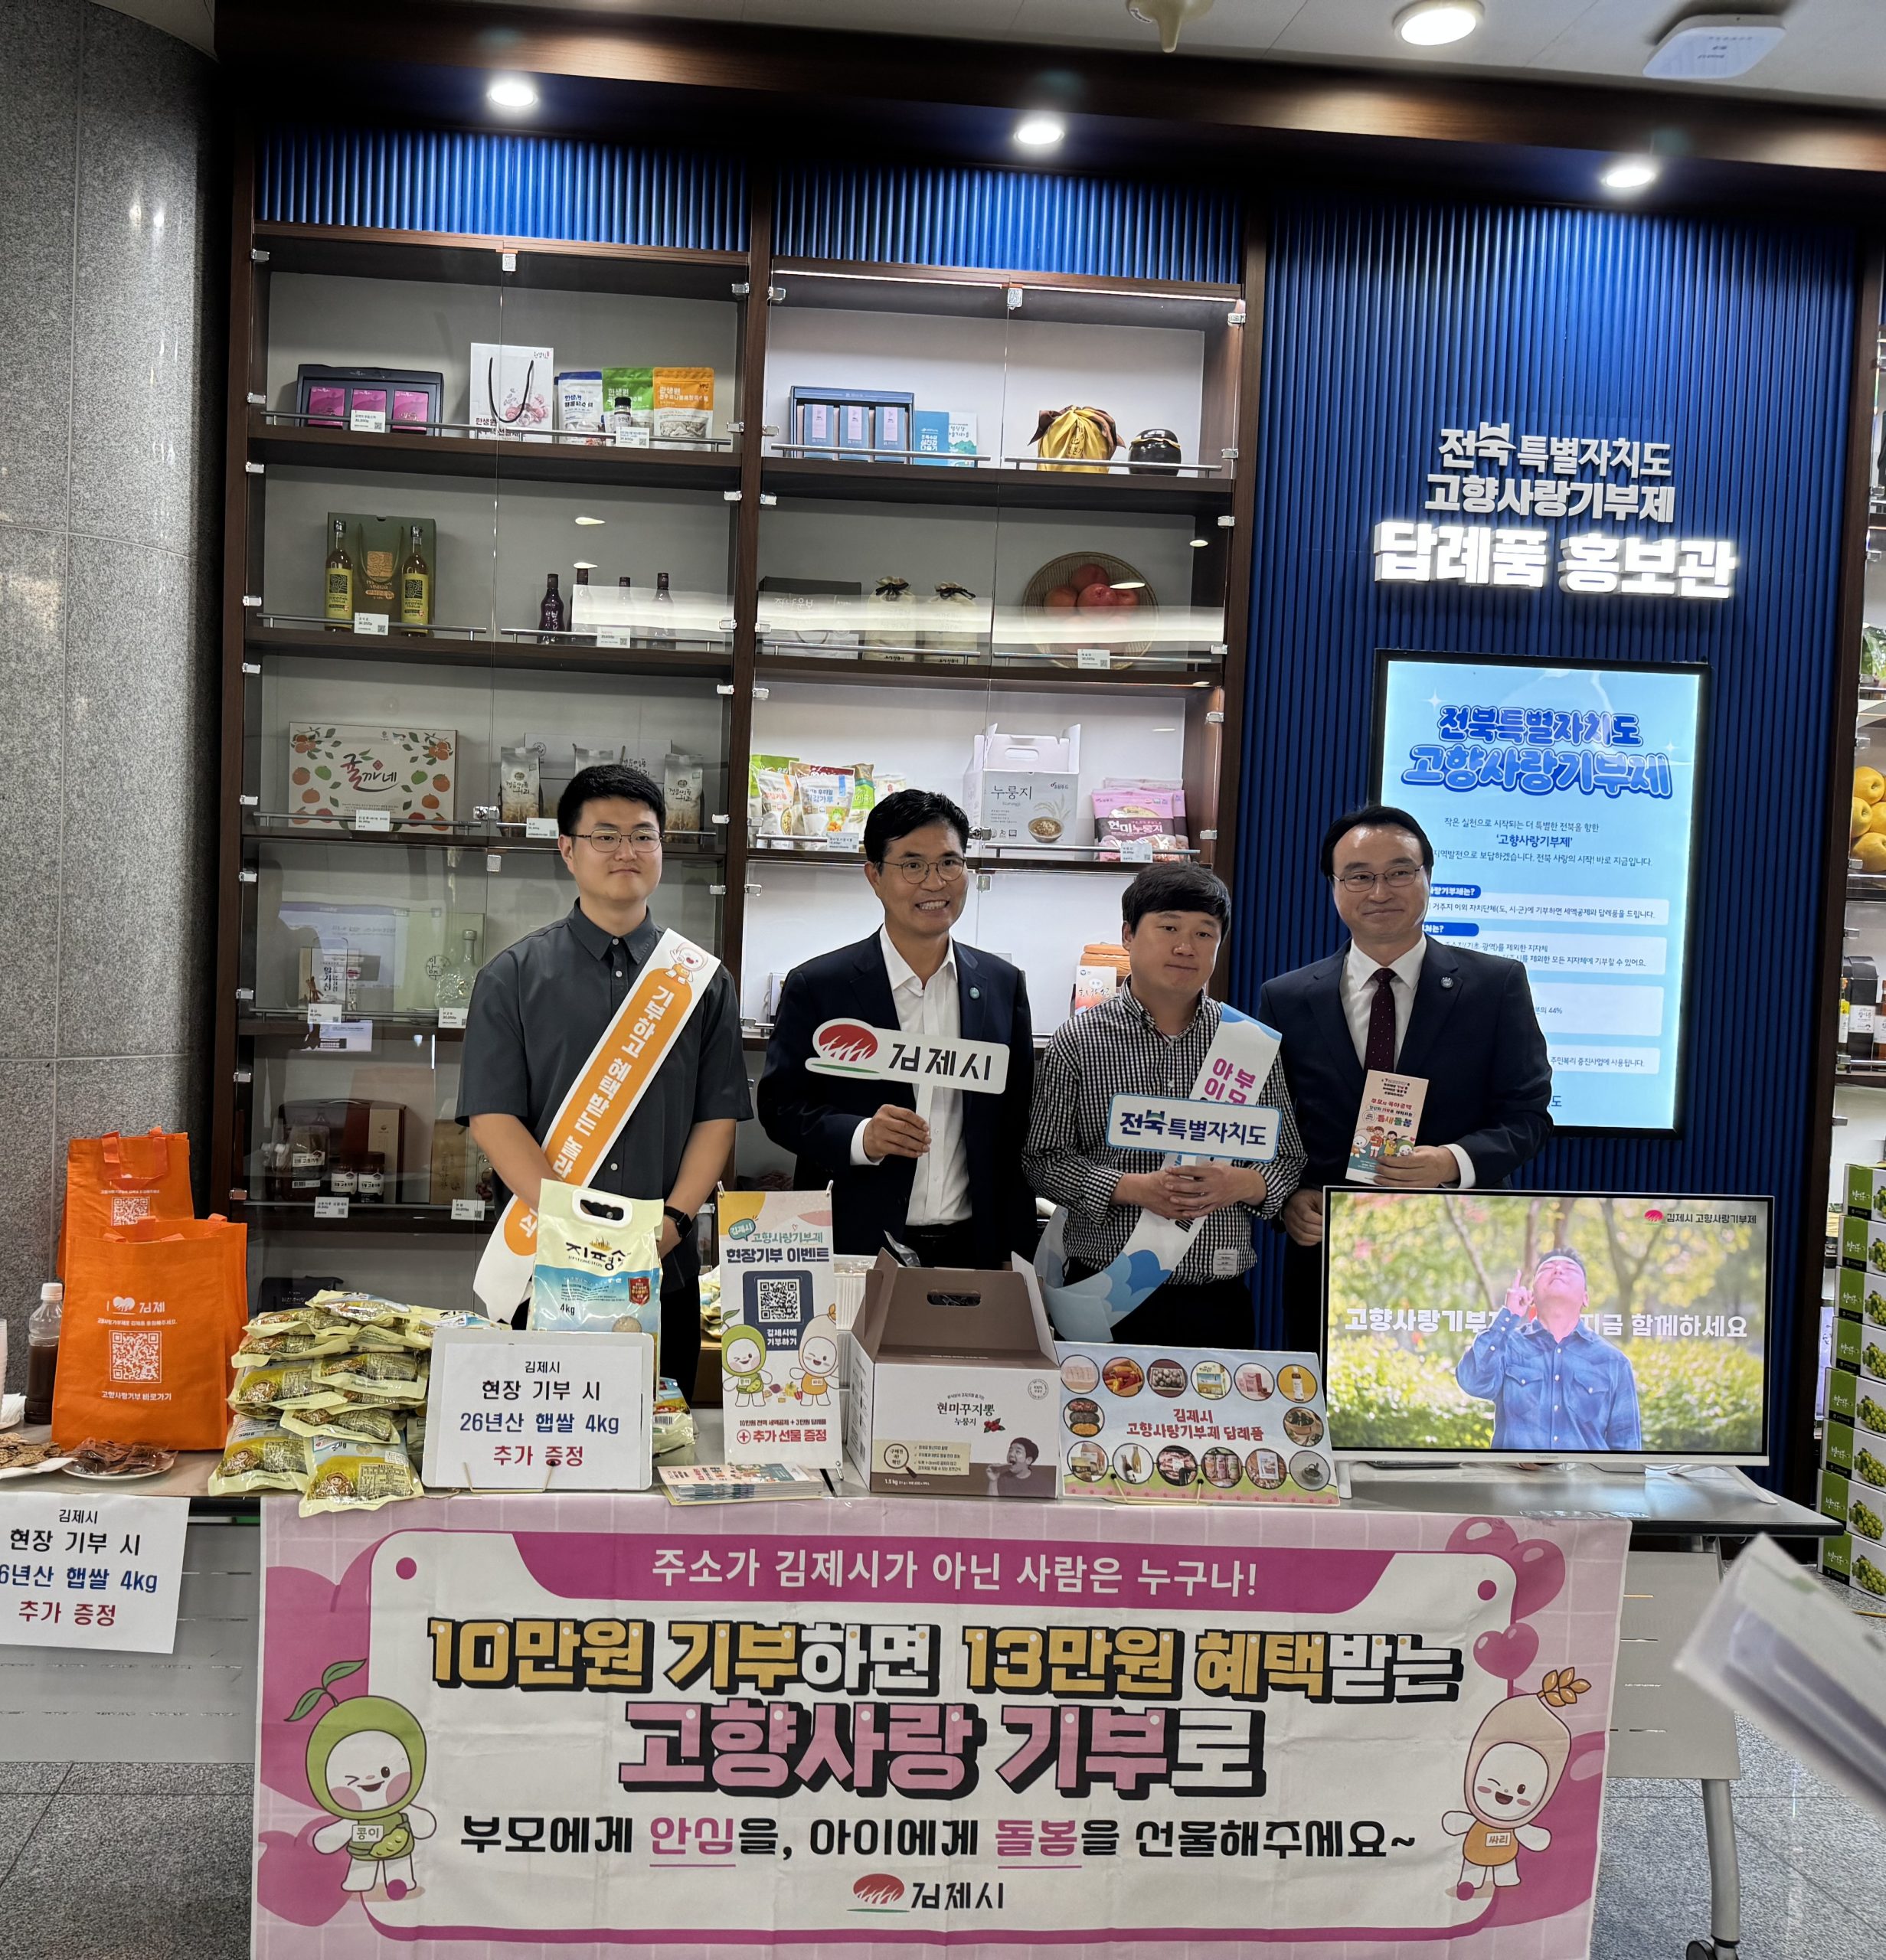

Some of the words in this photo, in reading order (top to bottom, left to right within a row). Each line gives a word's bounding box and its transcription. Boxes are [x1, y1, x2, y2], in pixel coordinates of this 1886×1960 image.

[1424, 474, 1675, 523] 고향사랑기부제
[1374, 520, 1550, 588] 답례품
[1558, 531, 1741, 599] 홍보관
[1437, 704, 1643, 748] 전북특별자치도
[1401, 743, 1673, 799] 고향사랑기부제
[991, 786, 1032, 800] 누룽지
[1107, 820, 1163, 833] 현미누룽지
[1444, 817, 1459, 827] 작은
[1461, 818, 1492, 828] 실천으로
[1494, 819, 1524, 830] 시작되는
[1526, 821, 1534, 829] 더
[1535, 822, 1558, 831] 특별한
[1560, 822, 1582, 832] 전북을
[1584, 823, 1599, 833] 향한
[1537, 854, 1551, 863] 전북
[1553, 854, 1576, 864] 사랑의
[1577, 855, 1594, 864] 시작!
[1596, 856, 1612, 864] 바로
[1613, 857, 1652, 867] 지금입니다.
[1433, 903, 1453, 911] 거주지
[1535, 906, 1563, 916] 기부하면
[1564, 907, 1597, 917] 세액공제와
[1599, 909, 1625, 918] 답례품을
[1626, 910, 1655, 919] 드립니다.
[1506, 943, 1526, 953] 제외한
[1528, 944, 1548, 953] 지자체
[1530, 956, 1551, 965] 제외한
[1551, 956, 1566, 965] 모든
[1567, 957, 1593, 965] 지자체에
[1595, 958, 1615, 967] 기부할
[622, 985, 675, 1059] 기부하고
[888, 1043, 992, 1081] 김제시
[1577, 1057, 1610, 1067] 증진사업에
[1611, 1059, 1645, 1067] 사용됩니다.
[1200, 1058, 1234, 1101] 아이
[574, 1061, 632, 1137] 혜택받는
[1120, 1109, 1267, 1146] 전북특별자치도
[552, 1135, 583, 1181] 놀라
[1666, 1213, 1693, 1224] 김제시
[1695, 1213, 1757, 1225] 고향사랑기부제
[751, 1231, 823, 1244] 고향사랑기부제
[726, 1247, 783, 1263] 현장기부
[787, 1247, 830, 1263] 이벤트
[139, 1301, 165, 1313] 김제
[560, 1302, 575, 1315] 4kg
[1631, 1313, 1747, 1338] 함께하세요
[766, 1338, 797, 1346] 기부하기
[525, 1361, 561, 1374] 김제시
[101, 1390, 141, 1400] 고향사랑기부
[142, 1393, 172, 1401] 바로가기
[482, 1380, 521, 1400] 현장
[532, 1380, 570, 1400] 기부
[582, 1380, 601, 1401] 시
[460, 1413, 524, 1432] 26년산
[536, 1413, 575, 1433] 햅쌀
[585, 1413, 619, 1435] 4kg
[954, 1417, 976, 1426] 누룽지
[1173, 1408, 1214, 1423] 김제시
[753, 1429, 777, 1443] 추가
[779, 1429, 802, 1442] 선물
[804, 1429, 827, 1442] 증정
[1126, 1422, 1221, 1441] 고향사랑기부제
[1224, 1426, 1264, 1442] 답례품
[493, 1446, 533, 1467] 추가
[545, 1446, 583, 1467] 증정
[59, 1508, 98, 1524] 김제시
[10, 1528, 53, 1553] 현장
[65, 1531, 107, 1554] 기부
[119, 1534, 141, 1556] 시
[67, 1567, 109, 1590] 햅쌀
[120, 1570, 158, 1593] 4kg
[652, 1548, 760, 1587] 주소가
[775, 1550, 918, 1589] 김제시가
[933, 1552, 1000, 1591] 아닌
[1017, 1554, 1123, 1594] 사람은
[1137, 1559, 1257, 1596] 누구나!
[18, 1600, 62, 1623] 추가
[74, 1602, 116, 1626] 증정
[428, 1616, 655, 1694] 10만원
[664, 1619, 941, 1697] 기부하면
[963, 1625, 1186, 1701] 13만원
[1195, 1628, 1464, 1704] 혜택받는
[619, 1697, 988, 1800] 고향사랑
[995, 1704, 1267, 1801] 기부로
[356, 1826, 381, 1841] 콩이
[461, 1815, 633, 1854] 부모에게
[649, 1816, 793, 1861] 안심을,
[809, 1819, 978, 1857] 아이에게
[995, 1819, 1120, 1857] 돌봄을
[1136, 1819, 1416, 1860] 선물해주세요~
[1489, 1834, 1509, 1846] 싸리
[910, 1881, 1004, 1910] 김제시
